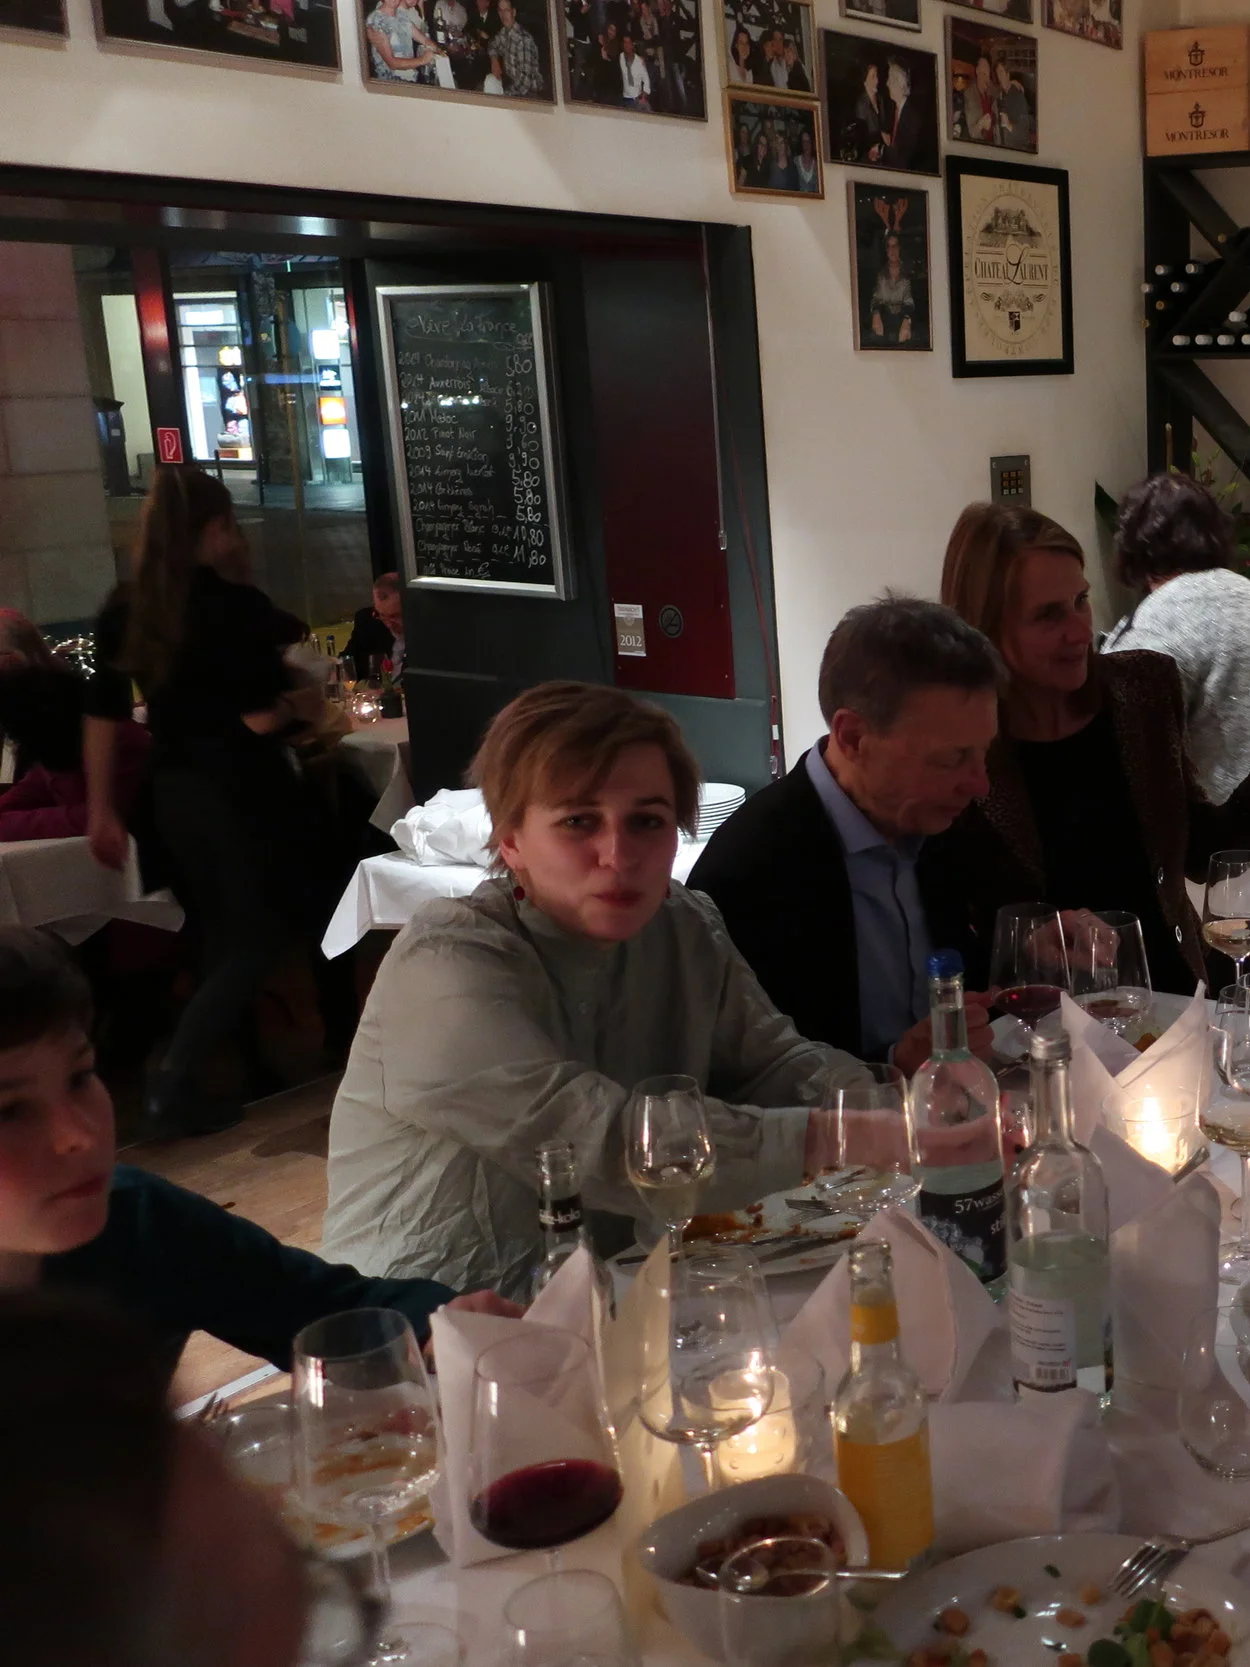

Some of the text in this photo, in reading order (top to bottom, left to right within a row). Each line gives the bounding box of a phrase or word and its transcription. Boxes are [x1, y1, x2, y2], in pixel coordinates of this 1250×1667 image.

[1164, 66, 1228, 81] MONTRESOR
[1165, 127, 1229, 142] MONTRESOR
[428, 376, 471, 391] Auxerrois
[404, 426, 429, 442] 2012
[406, 443, 431, 460] 2009
[619, 634, 643, 647] 2012
